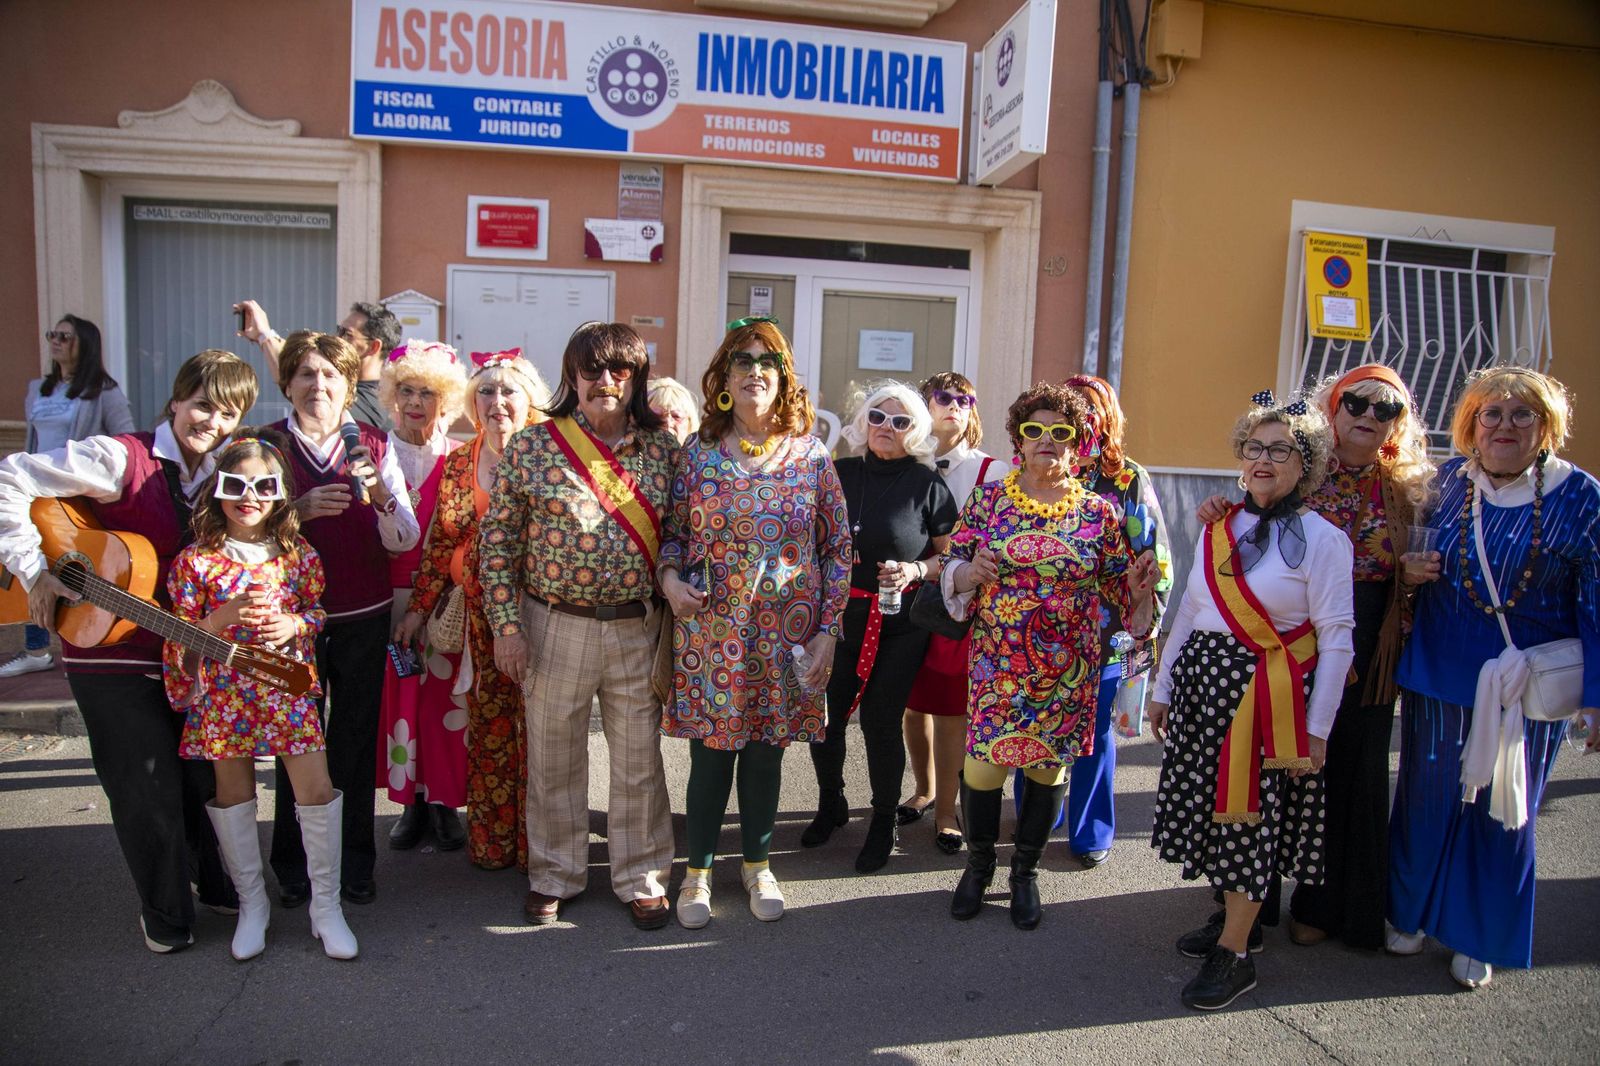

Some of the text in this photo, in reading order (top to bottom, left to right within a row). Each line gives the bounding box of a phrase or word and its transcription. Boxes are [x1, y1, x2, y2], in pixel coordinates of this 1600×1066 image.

[374, 7, 568, 81] ASESORIA
[586, 34, 680, 99] CASTILLO & MORENO
[696, 32, 945, 114] INMOBILIARIA
[373, 90, 563, 118] FISCAL CONTABLE
[373, 112, 563, 139] LABORAL JURIDICO
[703, 114, 941, 149] TERRENOS LOCALES
[702, 135, 940, 169] PROMOCIONES VIVIENDAS
[179, 208, 330, 227] castilloymoreno@gmail.com
